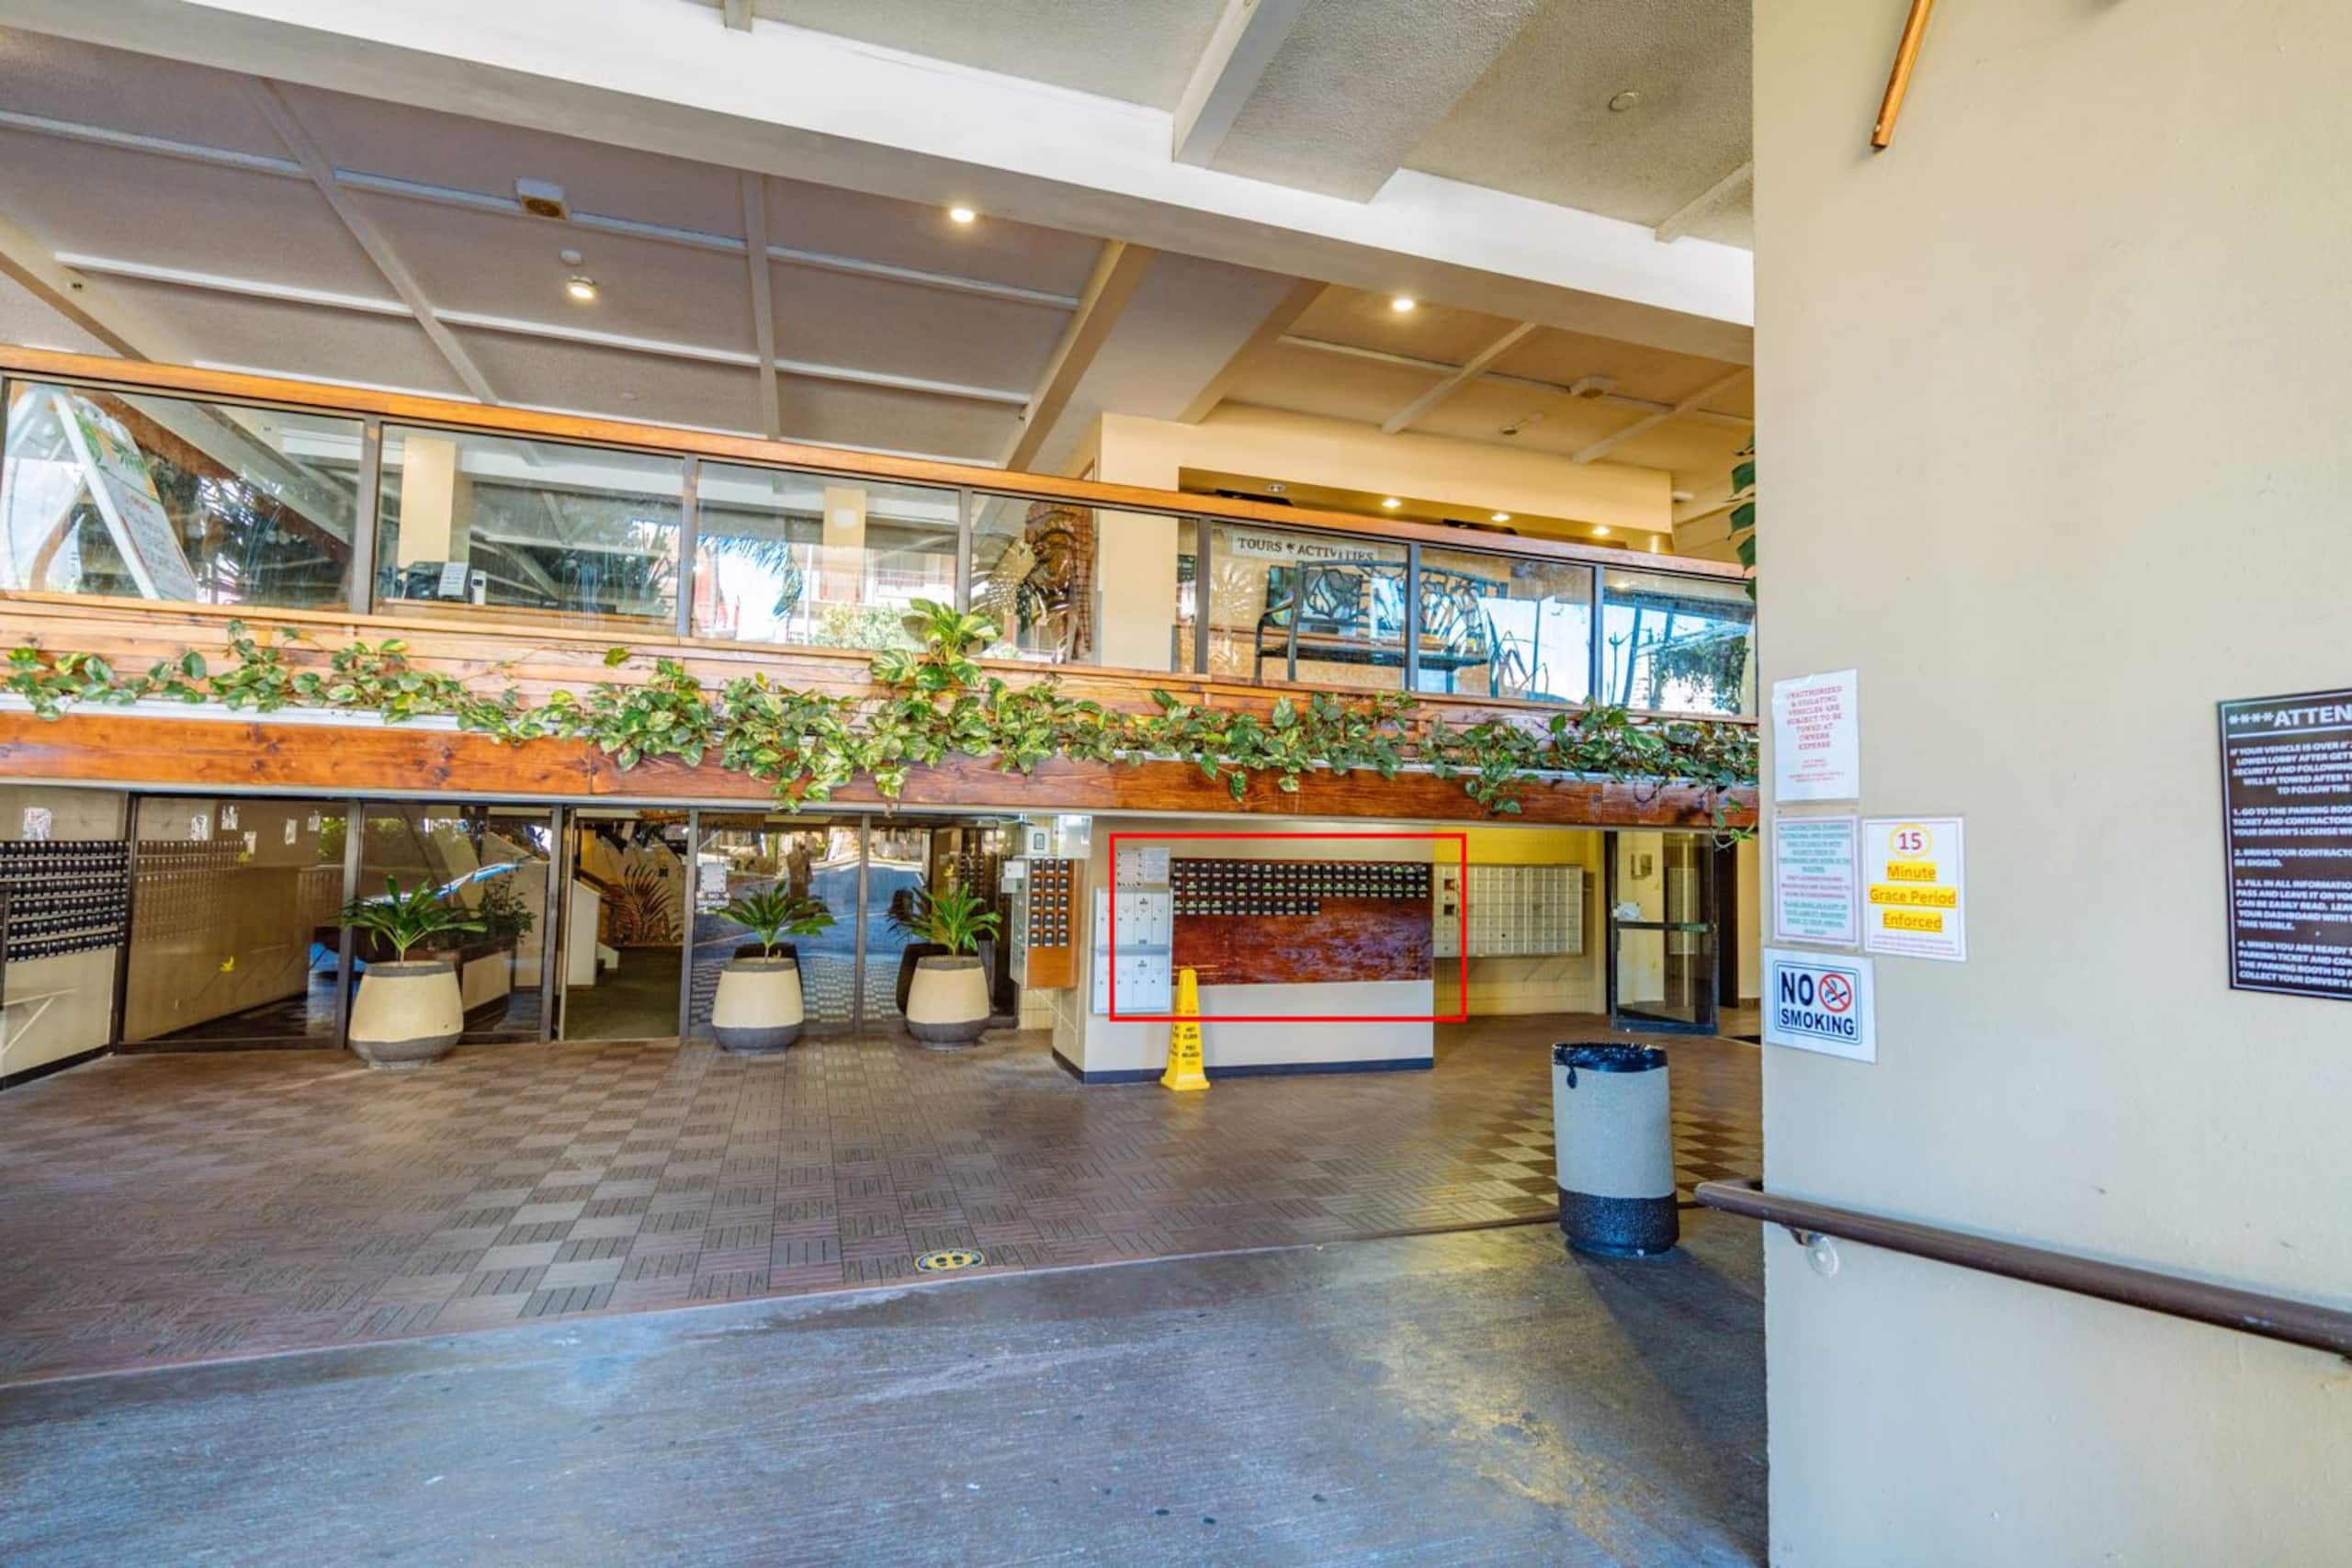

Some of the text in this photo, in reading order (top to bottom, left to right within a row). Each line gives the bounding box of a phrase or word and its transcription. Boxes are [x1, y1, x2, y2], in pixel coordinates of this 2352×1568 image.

[1238, 536, 1375, 561] TOURS ACTIVITIES
[2240, 747, 2262, 755] YOUR
[2264, 744, 2301, 754] VEHICLE
[2302, 743, 2311, 751] IS
[2312, 741, 2338, 750] OVER
[2236, 757, 2267, 766] LOWER
[2267, 755, 2297, 765] LOBBY
[2298, 753, 2327, 762] AFTER
[2233, 766, 2274, 776] SECURITY
[2275, 765, 2296, 774] AND
[2278, 775, 2312, 784] TOWED
[2312, 773, 2343, 783] AFTER
[2278, 786, 2290, 795] TO
[2291, 784, 2331, 795] FOLLOW
[2269, 807, 2287, 815] THE
[2289, 807, 2329, 815] PARKING
[2233, 818, 2262, 826] TICKET
[2263, 818, 2283, 826] AND
[2233, 828, 2257, 836] YOUR
[2300, 828, 2337, 836] LICENSE
[1898, 832, 1923, 851] 15
[2272, 848, 2296, 856] YOUR
[1886, 865, 1937, 880] Minute
[2275, 880, 2291, 888] ALL
[1869, 888, 1957, 905] Grace Period
[2258, 889, 2279, 897] AND
[2279, 890, 2308, 898] LEAVE
[2319, 891, 2335, 899] ON
[1883, 913, 1942, 930] Enforced
[2238, 909, 2263, 918] YOUR
[2263, 910, 2321, 921] DASHBOARD
[2322, 913, 2348, 922] WITH
[2275, 942, 2295, 951] YOU
[2296, 943, 2314, 953] ARE
[2315, 945, 2347, 954] READY
[2238, 950, 2277, 960] PARKING
[2278, 953, 2309, 962] TICKET
[2310, 955, 2332, 964] AND
[2239, 961, 2256, 969] THE
[2256, 962, 2296, 972] PARKING
[2332, 967, 2346, 976] TO
[2238, 970, 2278, 981] COLLECT
[2278, 974, 2303, 983] YOUR
[1781, 971, 1814, 1007] NO
[1781, 1009, 1854, 1036] SMOKING
